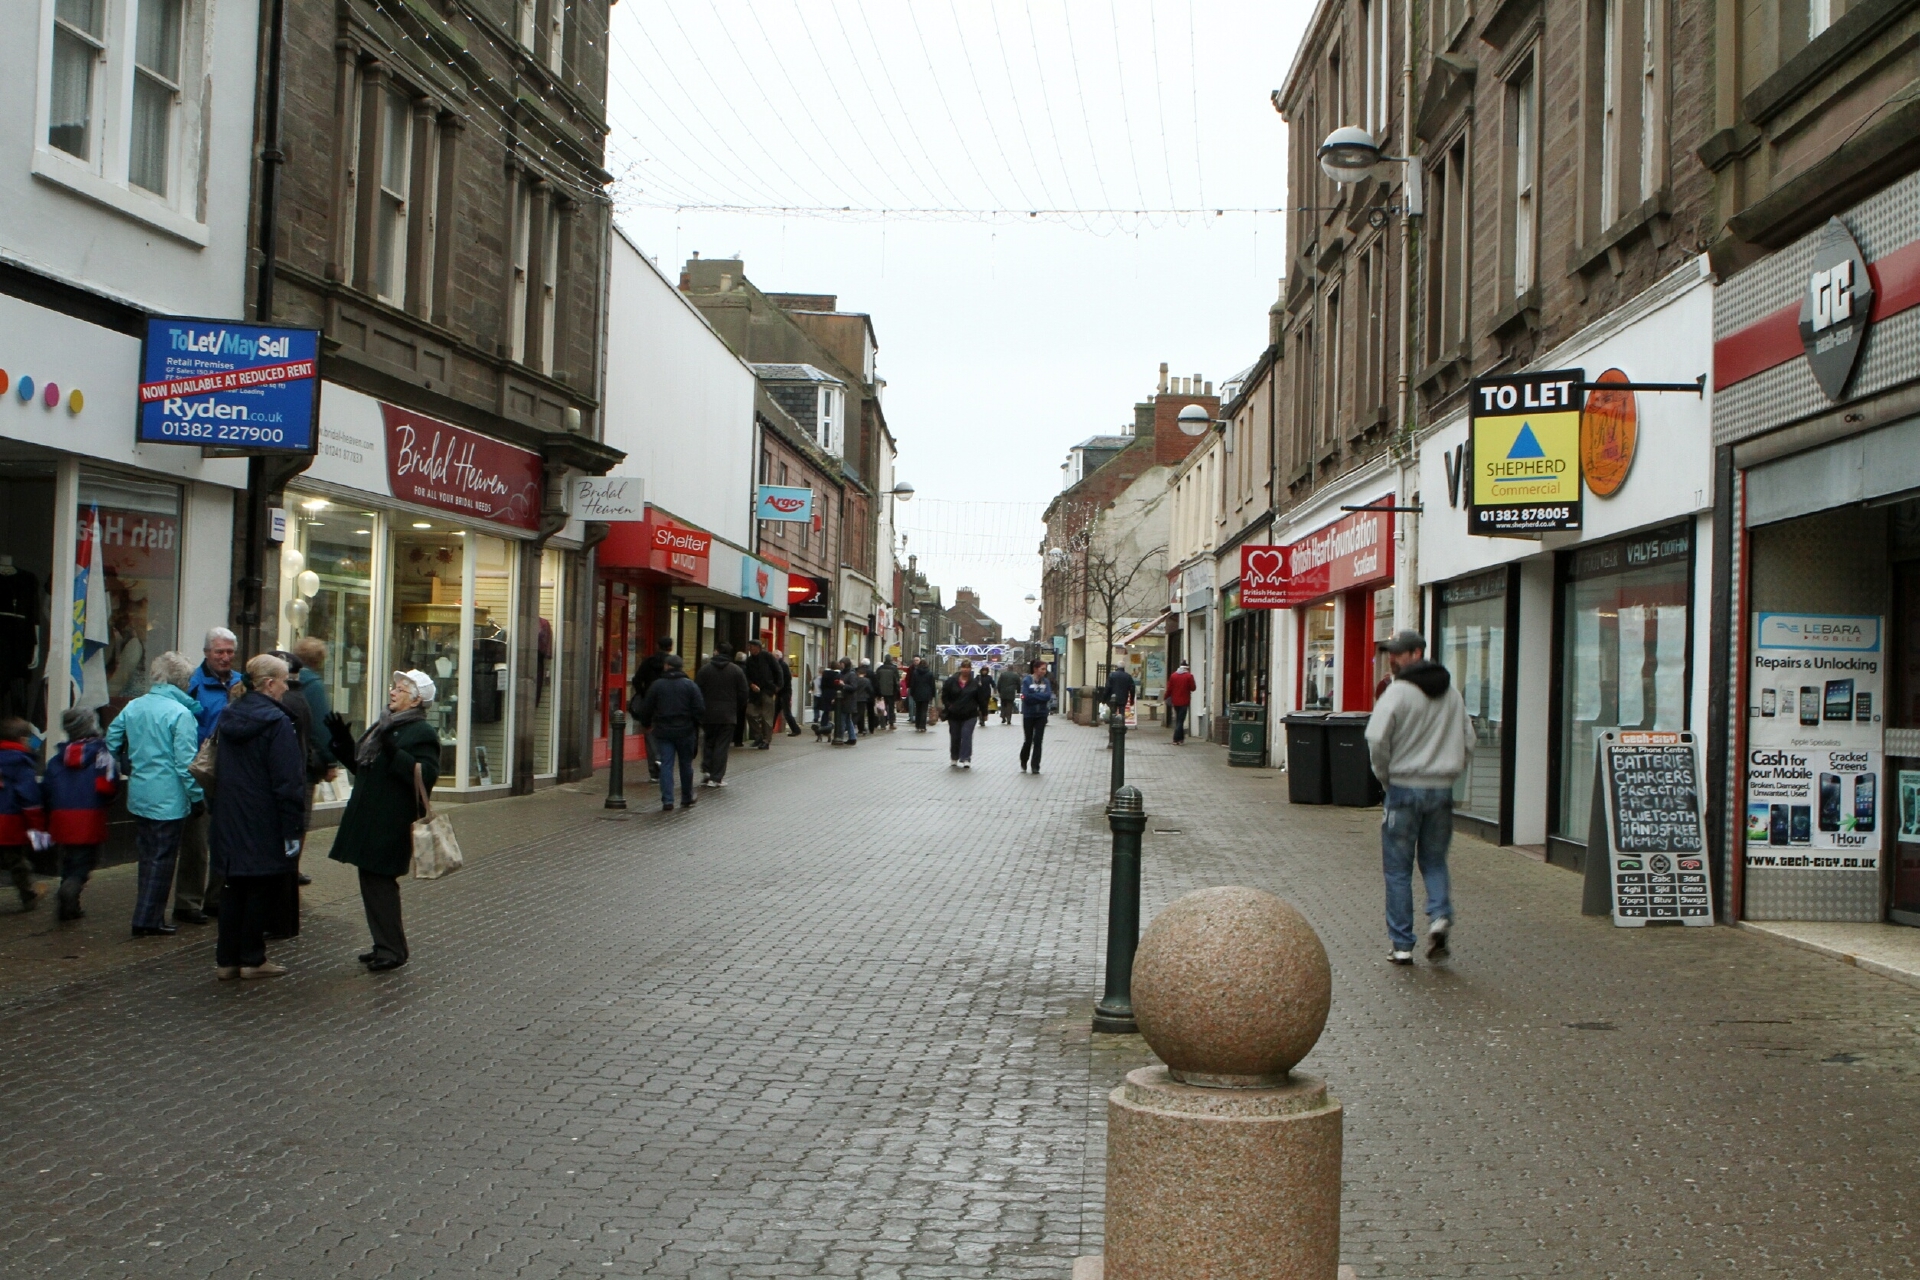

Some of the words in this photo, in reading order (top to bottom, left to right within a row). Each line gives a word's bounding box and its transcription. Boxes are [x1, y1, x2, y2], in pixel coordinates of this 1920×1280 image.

[166, 358, 193, 367] Retail
[194, 359, 235, 370] Premises
[142, 384, 168, 400] NOW
[170, 379, 222, 396] AVAILABLE
[225, 374, 238, 386] AT
[240, 366, 286, 385] REDUCED
[287, 362, 312, 377] RENT
[240, 388, 265, 396] Loading
[1480, 385, 1518, 410] TO
[1524, 380, 1574, 407] LET
[162, 421, 213, 438] 01382
[218, 425, 284, 442] 227900
[396, 424, 456, 486] Bridal
[454, 442, 508, 496] Heaven
[1486, 458, 1566, 477] SHEPHERD
[578, 480, 628, 500] Bridal
[1491, 482, 1561, 497] Commercial
[414, 486, 426, 496] FOR
[427, 488, 437, 500] ALL
[439, 491, 454, 504] YOUR
[455, 494, 473, 510] BRIDAL
[475, 499, 492, 513] NEEDS
[764, 495, 806, 512] Argos
[582, 498, 636, 516] Heaven
[1480, 510, 1519, 523] 01382
[1522, 507, 1570, 521] 878005
[1496, 520, 1556, 530] www.shepherd.co.uk
[656, 529, 708, 551] Shelter
[1312, 532, 1331, 566] Heart
[1331, 512, 1377, 560] Foundation
[1627, 540, 1659, 562] VALYS
[1353, 548, 1377, 577] Scotland
[1266, 588, 1286, 596] Heart
[1243, 596, 1287, 604] Foundation
[1804, 624, 1862, 635] LEBARA
[1755, 656, 1802, 671] Repairs
[1803, 660, 1812, 668] &
[1814, 657, 1878, 674] Unlocking
[1791, 738, 1809, 747] Apple
[1810, 738, 1842, 747] Specialists
[1612, 746, 1636, 754] Mobile
[1664, 746, 1688, 754] Centre
[1828, 752, 1868, 762] Cracked
[1613, 754, 1694, 770] BATTERIES
[1751, 750, 1788, 766] Cash
[1790, 754, 1808, 766] for
[1830, 761, 1868, 772] Screens
[1614, 770, 1693, 786] CHARGERS
[1772, 768, 1813, 780] Mobile
[1750, 782, 1776, 790] Broken,
[1776, 782, 1810, 791] Damaged,
[1754, 790, 1790, 798] Unwanted,
[1790, 790, 1808, 798] Used
[1620, 797, 1688, 810] FACIAS
[1620, 809, 1697, 822] BLUETOOTH
[1620, 822, 1698, 836] HANDSFREE
[1673, 836, 1702, 849] CARD
[1623, 886, 1641, 894] 4ghi
[1621, 897, 1645, 905] 7pqrs
